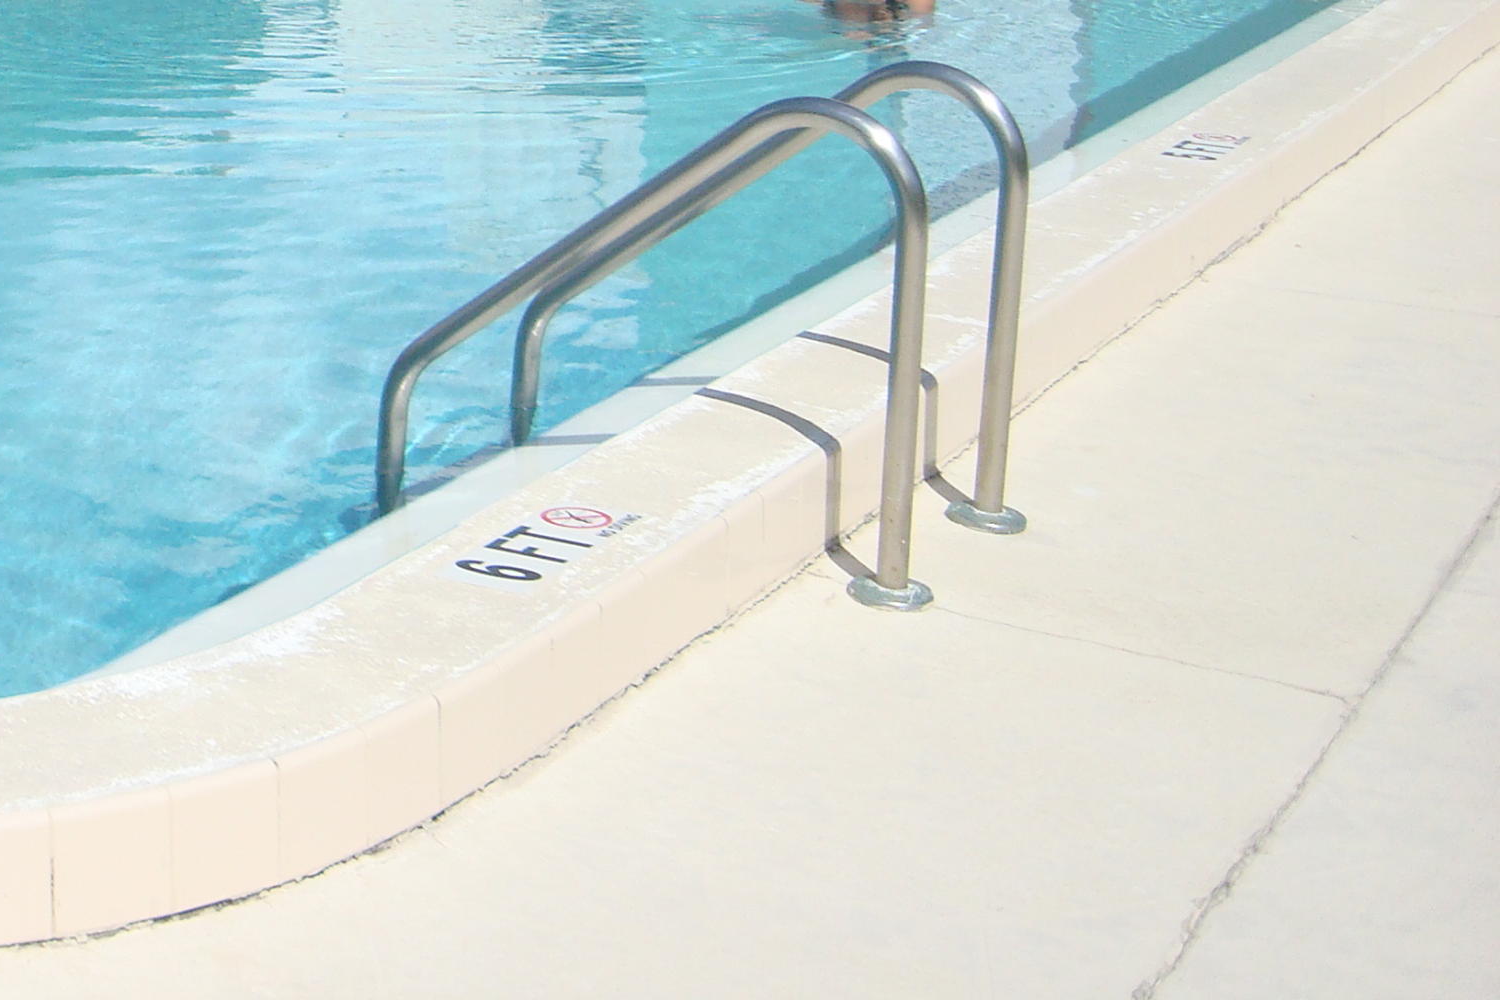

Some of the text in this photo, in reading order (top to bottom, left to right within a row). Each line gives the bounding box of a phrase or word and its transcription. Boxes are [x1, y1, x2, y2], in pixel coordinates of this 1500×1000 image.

[1172, 140, 1235, 155] FT
[455, 525, 594, 581] 6 FT
